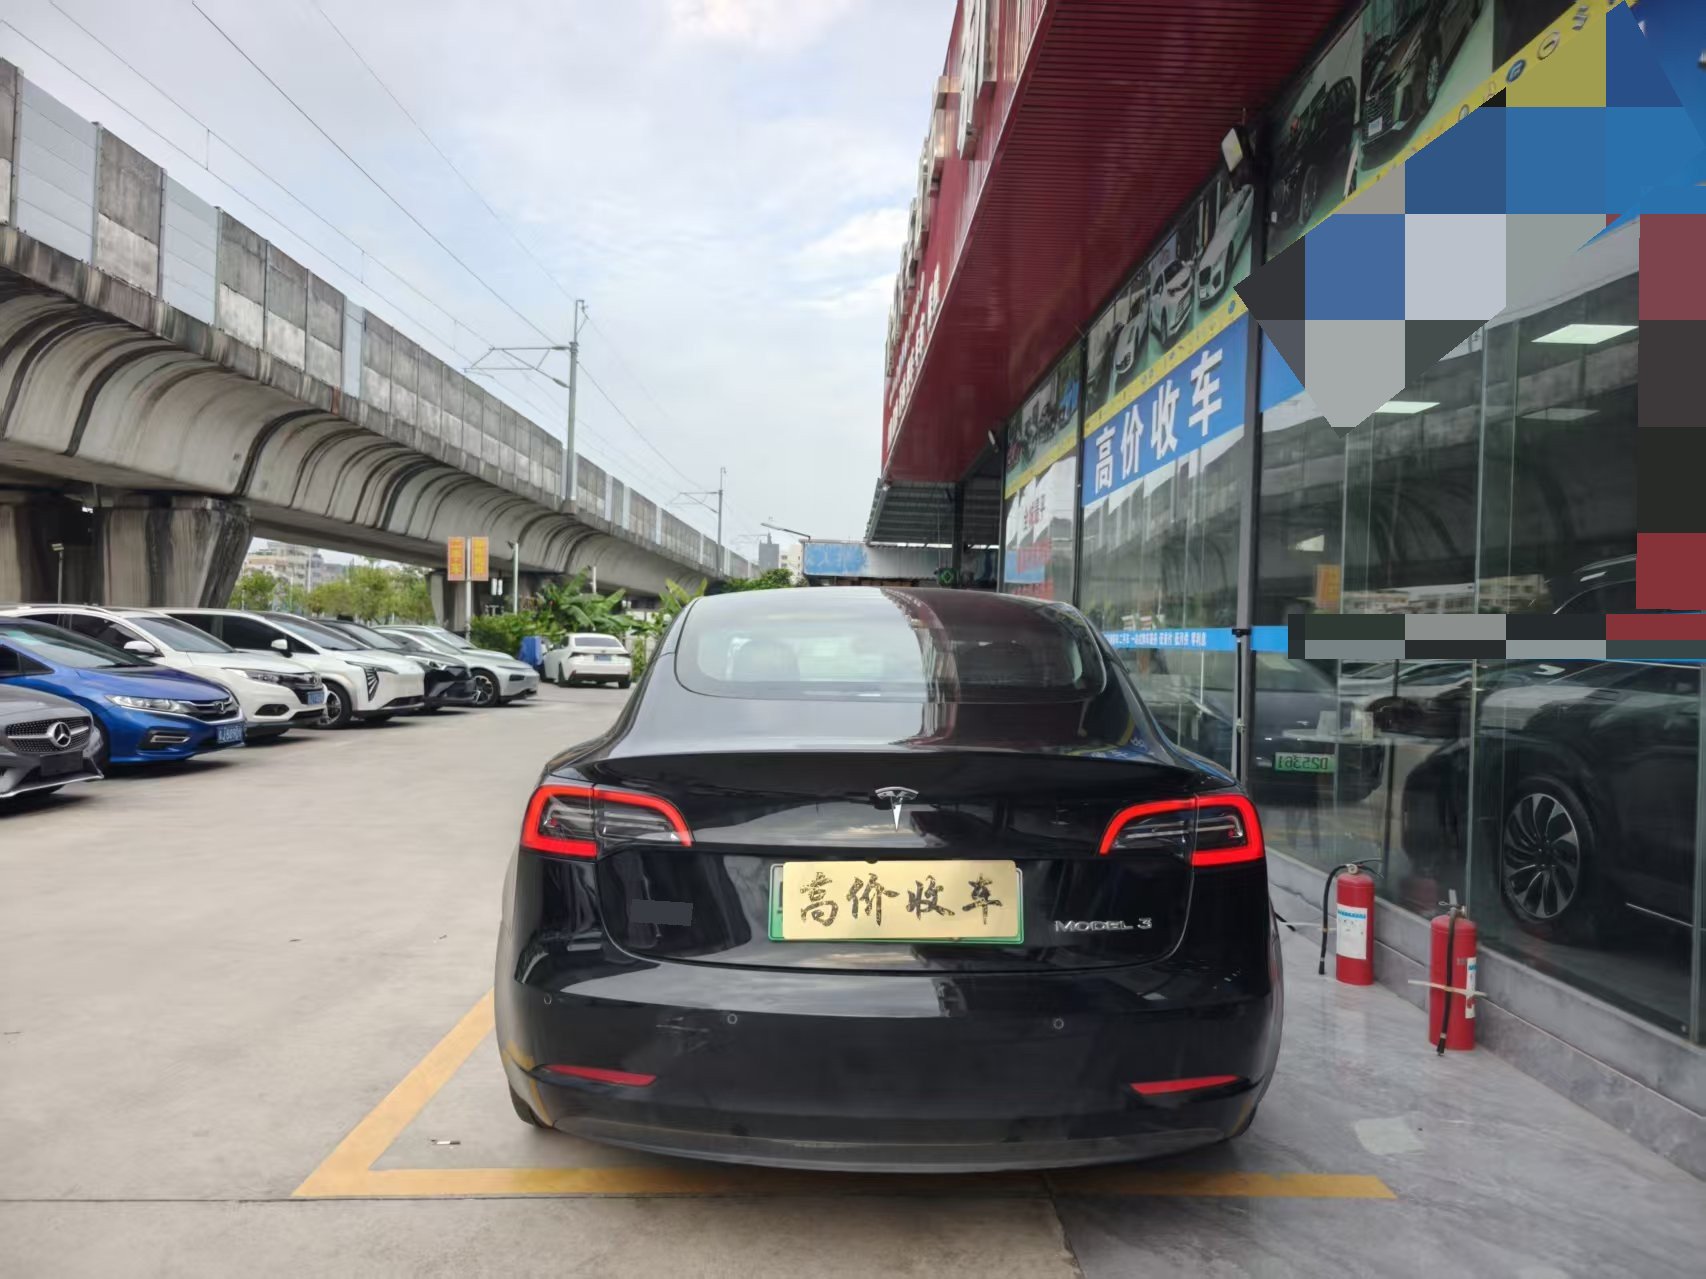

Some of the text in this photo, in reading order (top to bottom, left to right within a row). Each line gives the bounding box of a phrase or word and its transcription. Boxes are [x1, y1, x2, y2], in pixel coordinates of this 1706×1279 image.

[1095, 348, 1223, 494] 高价收车
[799, 871, 1003, 926] 高价收车
[1054, 917, 1152, 932] MODEL 3
